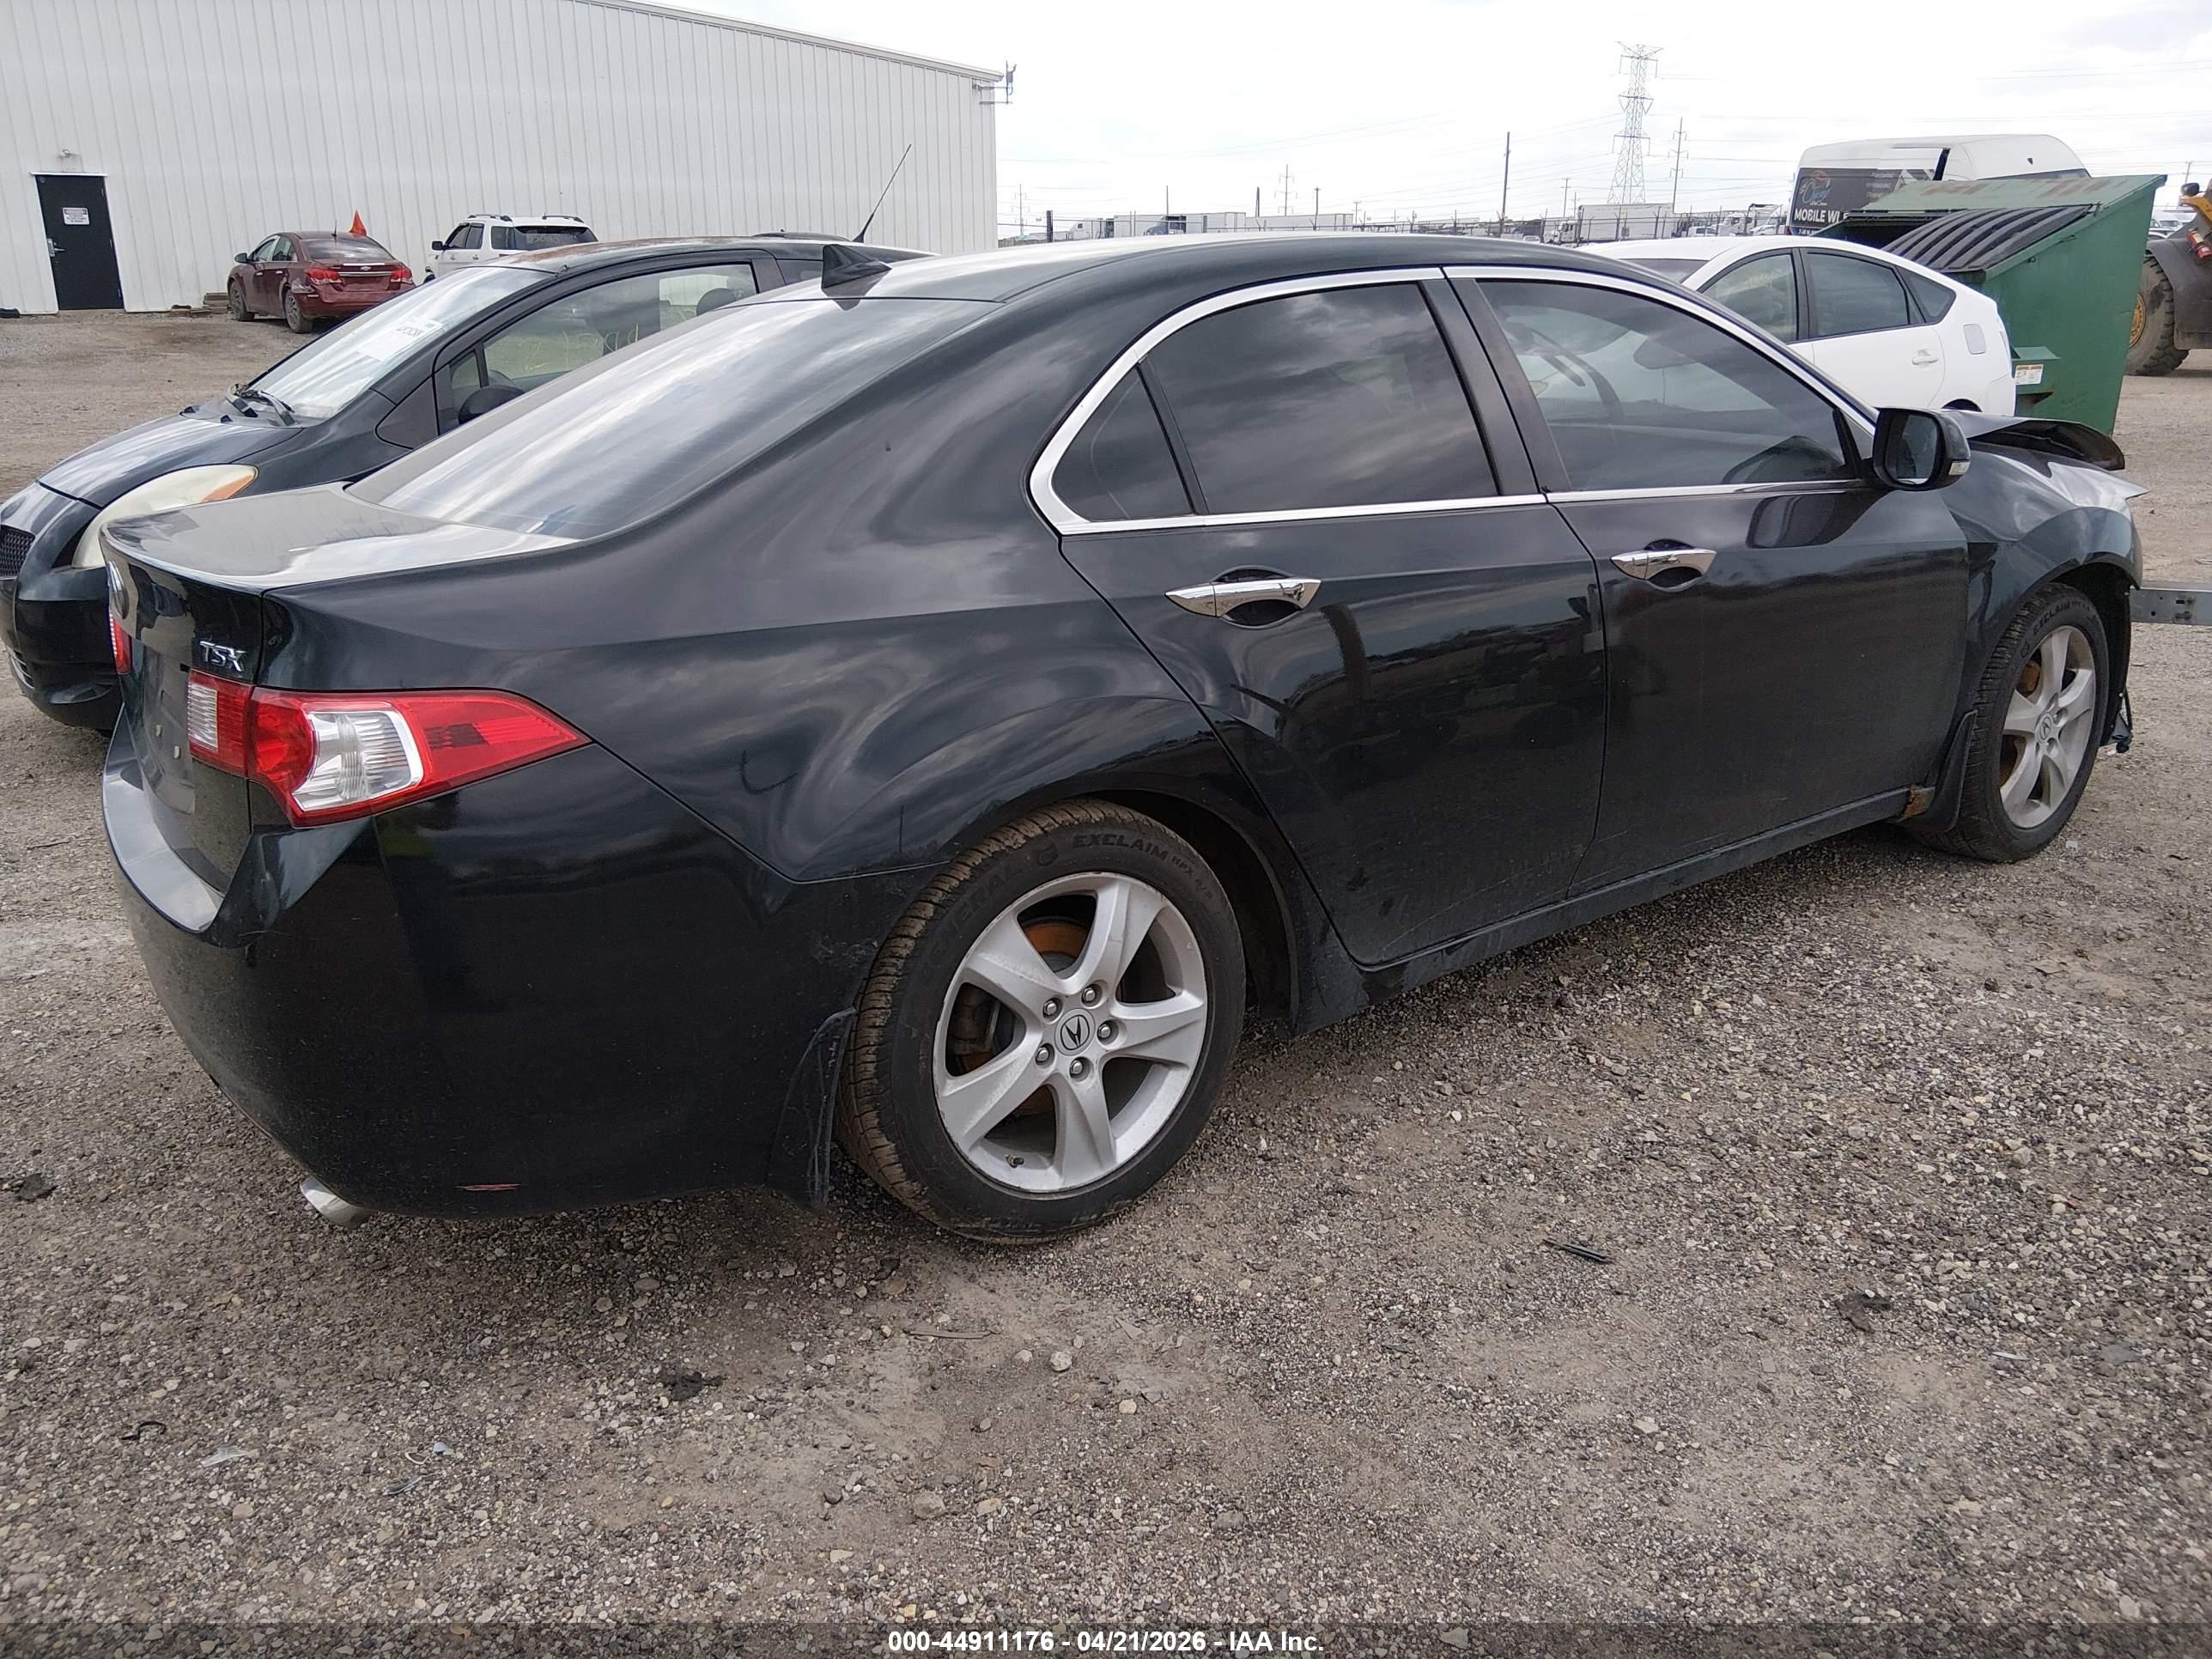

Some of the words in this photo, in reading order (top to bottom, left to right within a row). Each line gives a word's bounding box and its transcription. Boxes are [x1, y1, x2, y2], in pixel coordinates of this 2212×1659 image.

[1795, 208, 1826, 222] MOBILE
[199, 641, 246, 672] TSX
[1073, 834, 1169, 860] EXCLAIM
